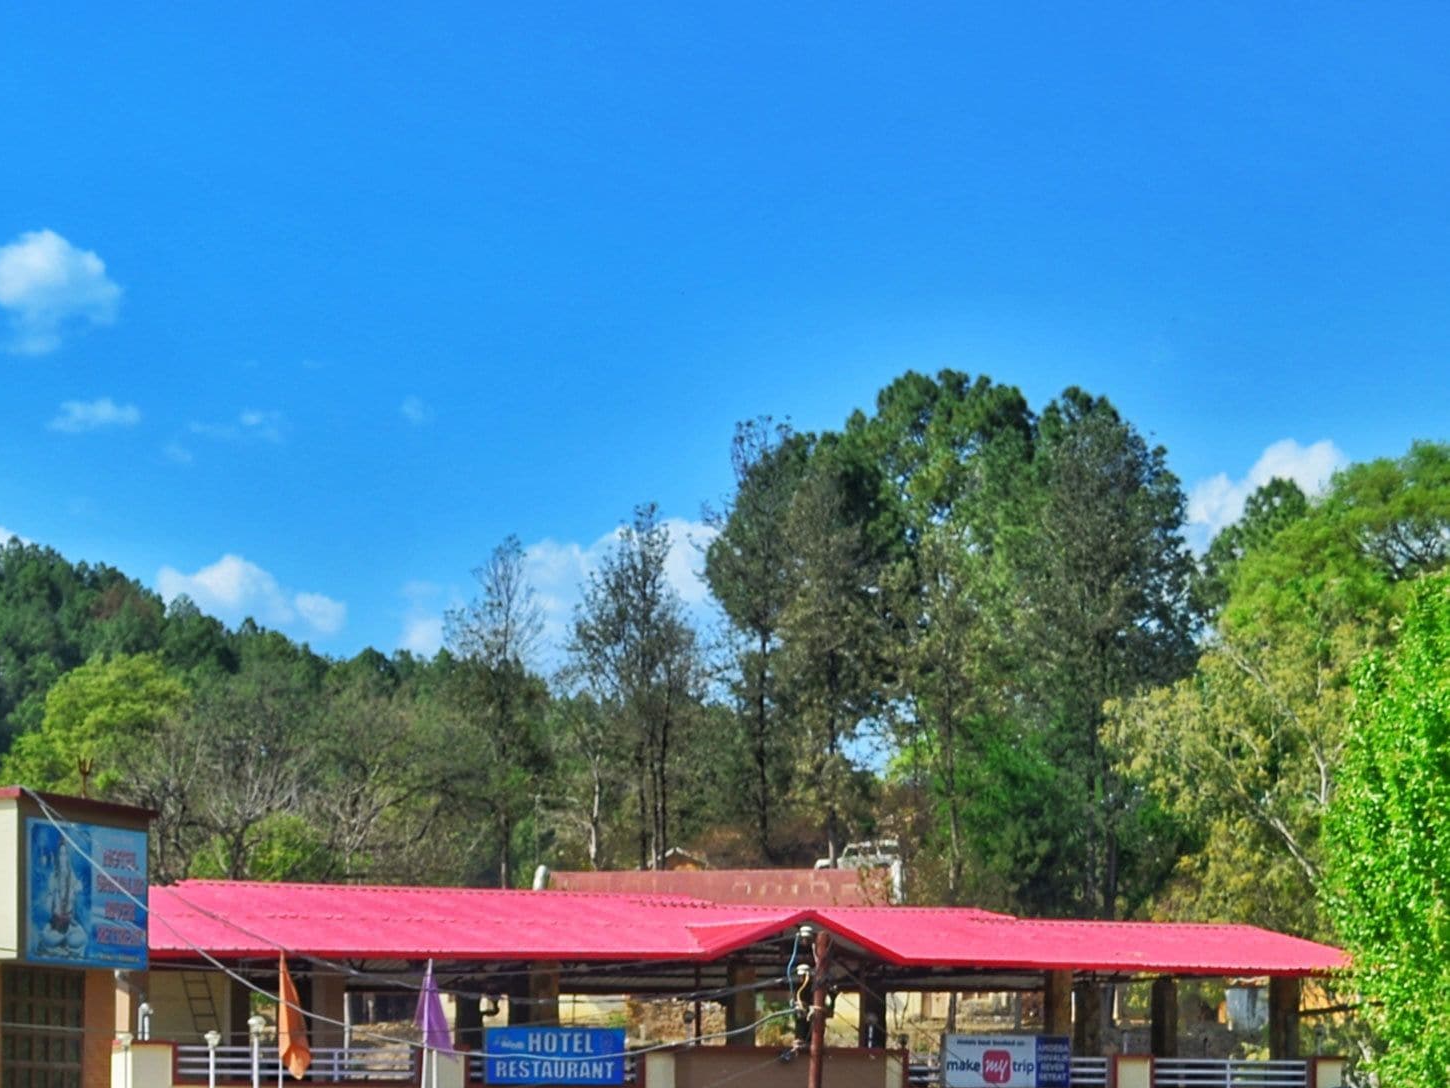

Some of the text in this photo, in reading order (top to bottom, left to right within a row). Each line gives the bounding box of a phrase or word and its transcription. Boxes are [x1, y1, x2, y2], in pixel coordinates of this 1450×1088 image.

[528, 1032, 594, 1054] HOTEL
[495, 1060, 615, 1079] RESTAURANT
[946, 1059, 1035, 1081] make my trip
